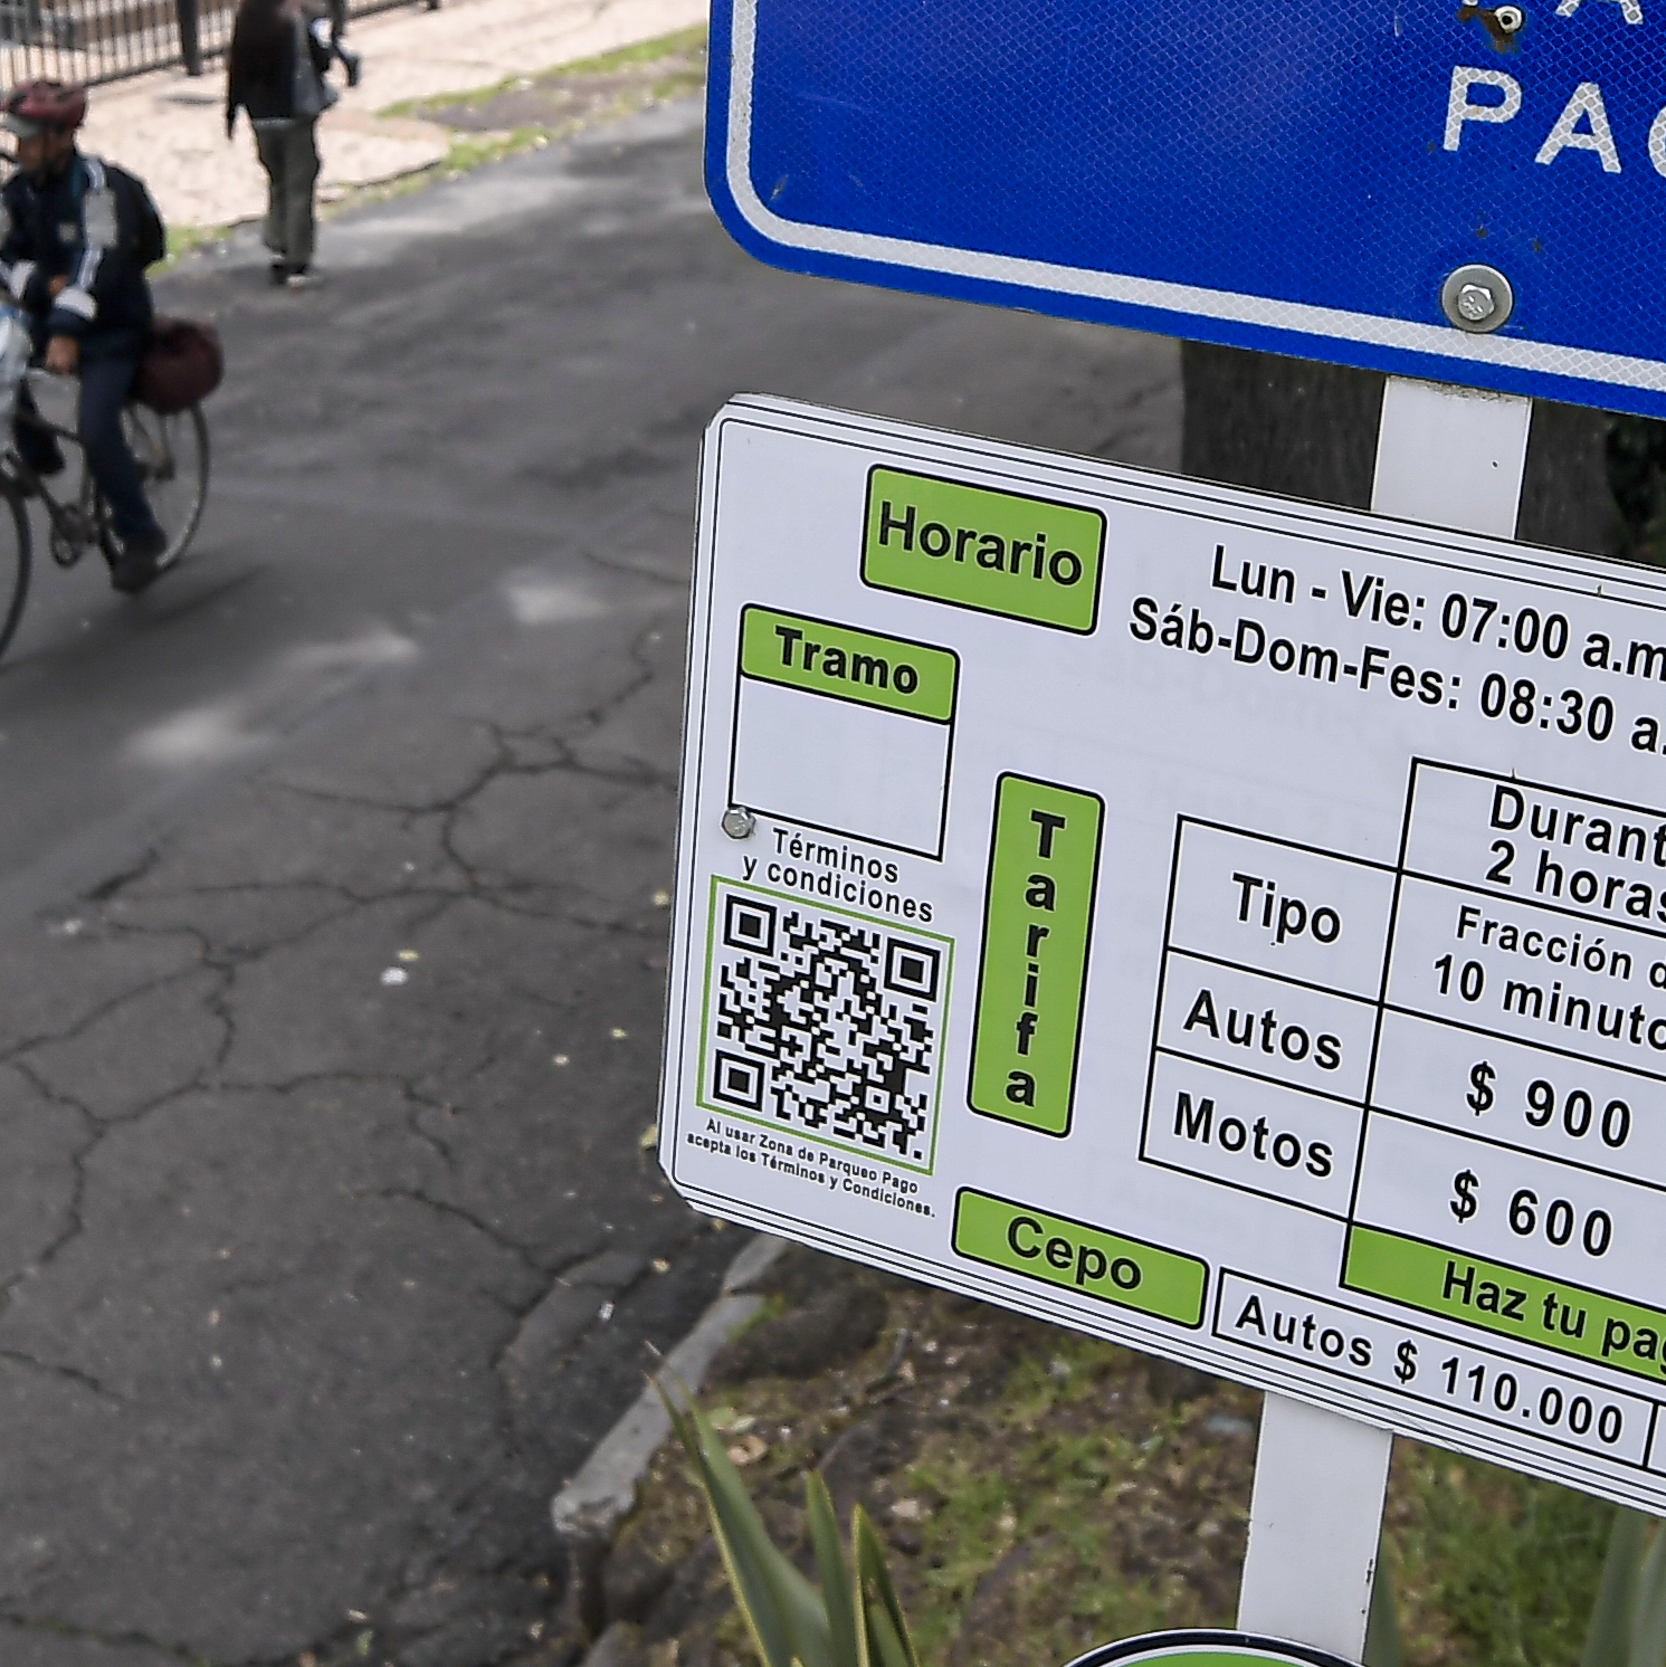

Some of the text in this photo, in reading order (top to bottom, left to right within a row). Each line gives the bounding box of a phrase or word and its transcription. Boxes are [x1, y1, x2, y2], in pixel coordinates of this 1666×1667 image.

[877, 500, 1085, 587] Horario
[1211, 544, 1295, 604] Lun
[1311, 587, 1327, 599] -
[1341, 570, 1425, 631] Vie:
[1442, 593, 1569, 659] 07:00
[774, 624, 919, 696] Tramo
[1129, 597, 1461, 709] Sáb-Dom-Fes:
[1480, 673, 1614, 742] 08:30
[741, 856, 933, 923] y condiciones
[772, 827, 898, 883] Términos
[1485, 839, 1515, 885] 2
[1232, 872, 1341, 944] Tipo
[1456, 904, 1632, 980] Fracción
[1007, 810, 1065, 1107] Tarifa
[1434, 954, 1484, 1002] 10
[1183, 988, 1343, 1071] Autos
[1173, 1091, 1334, 1178] Motos
[1466, 1060, 1631, 1148] $ 900
[686, 1133, 936, 1218] acepta los Términos y Condiciones.
[705, 1117, 918, 1194] Al usar Zona de Parqueo Pago
[1007, 1216, 1142, 1290] Cepo
[1449, 1169, 1612, 1257] $ 600
[1442, 1260, 1527, 1322] Haz
[1542, 1292, 1587, 1339] tu
[1236, 1294, 1623, 1444] Autos $ 110.000
